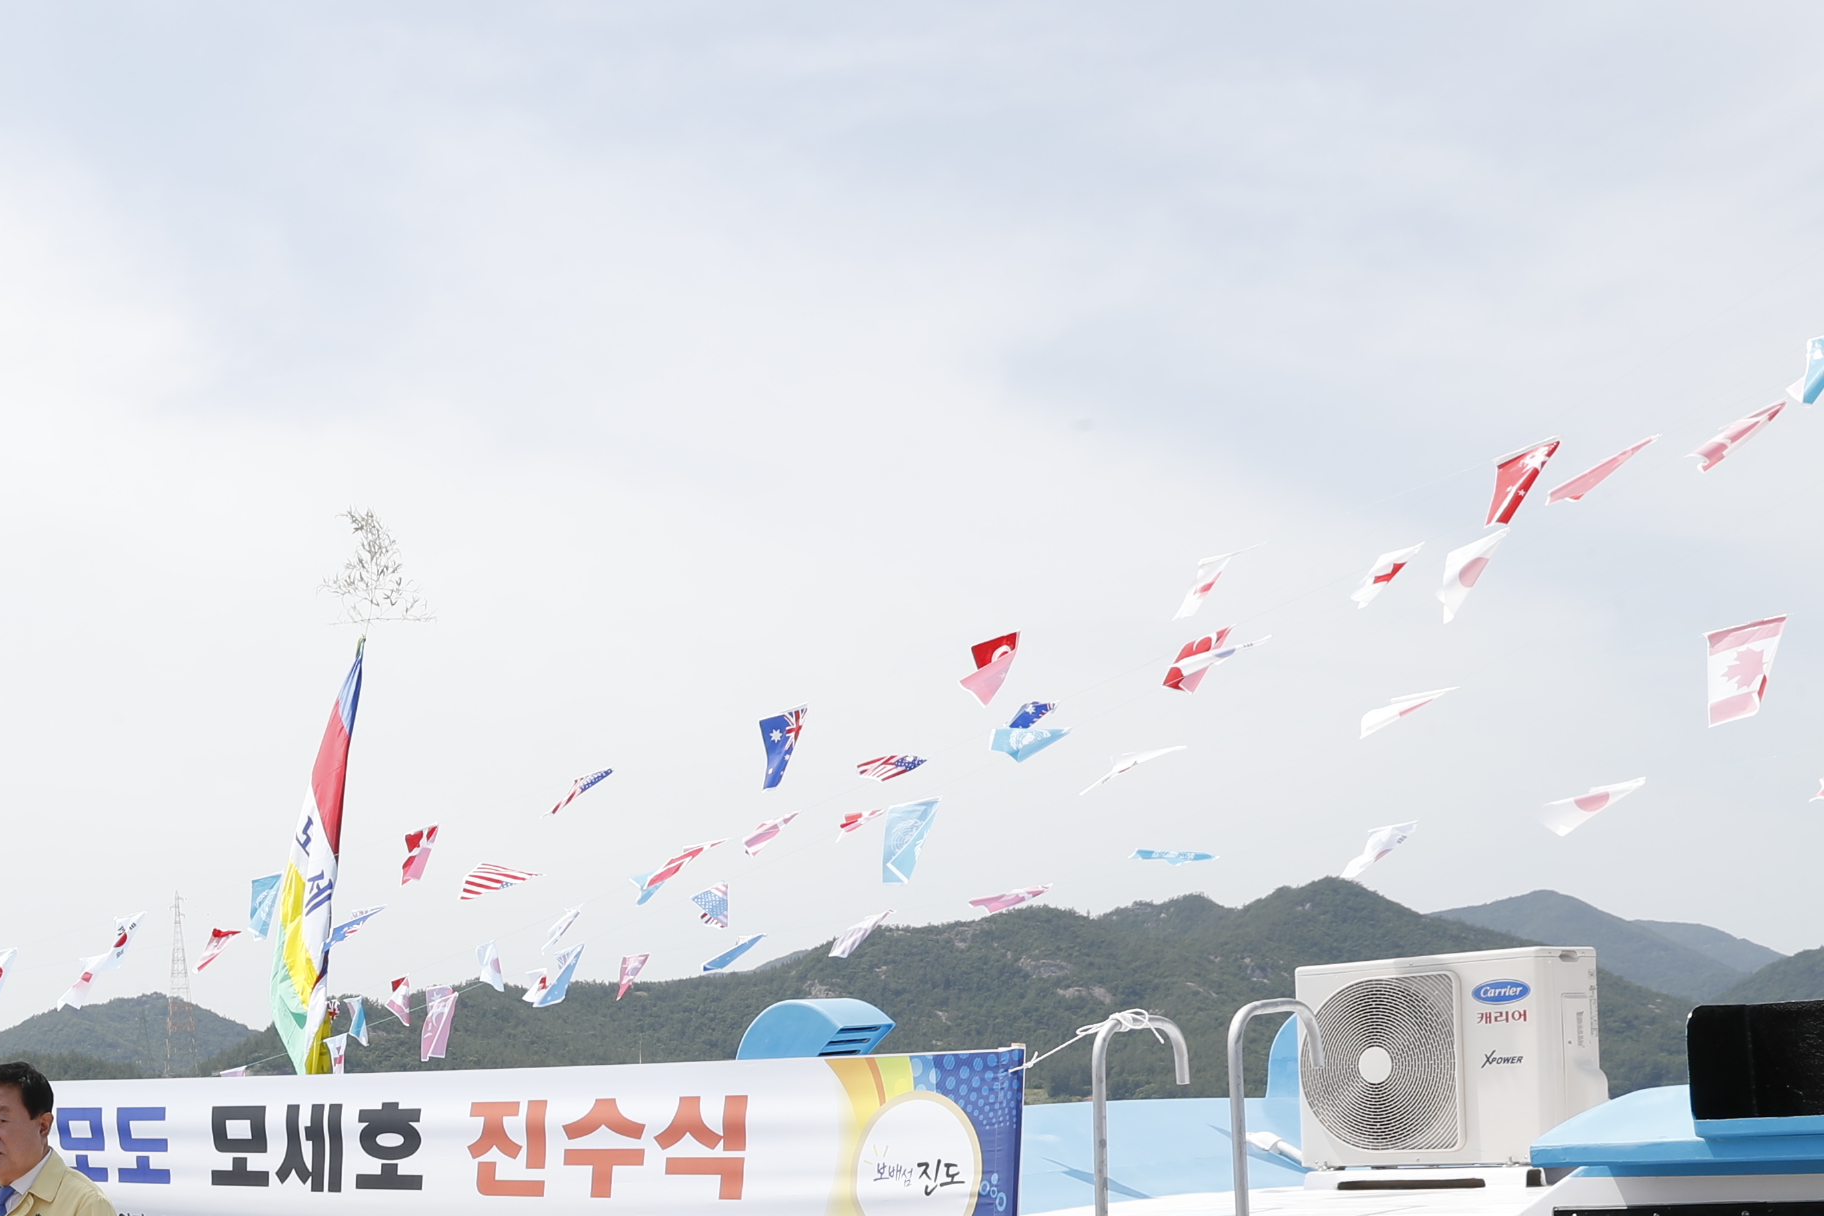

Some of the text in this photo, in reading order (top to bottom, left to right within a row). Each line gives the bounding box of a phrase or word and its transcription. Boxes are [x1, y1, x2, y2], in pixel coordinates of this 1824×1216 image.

[1480, 985, 1523, 998] Carrier
[1476, 1009, 1528, 1025] 캐리어
[209, 1101, 423, 1193] 모세호
[467, 1094, 749, 1200] 진수식
[873, 1159, 966, 1197] 보배섬 진도
